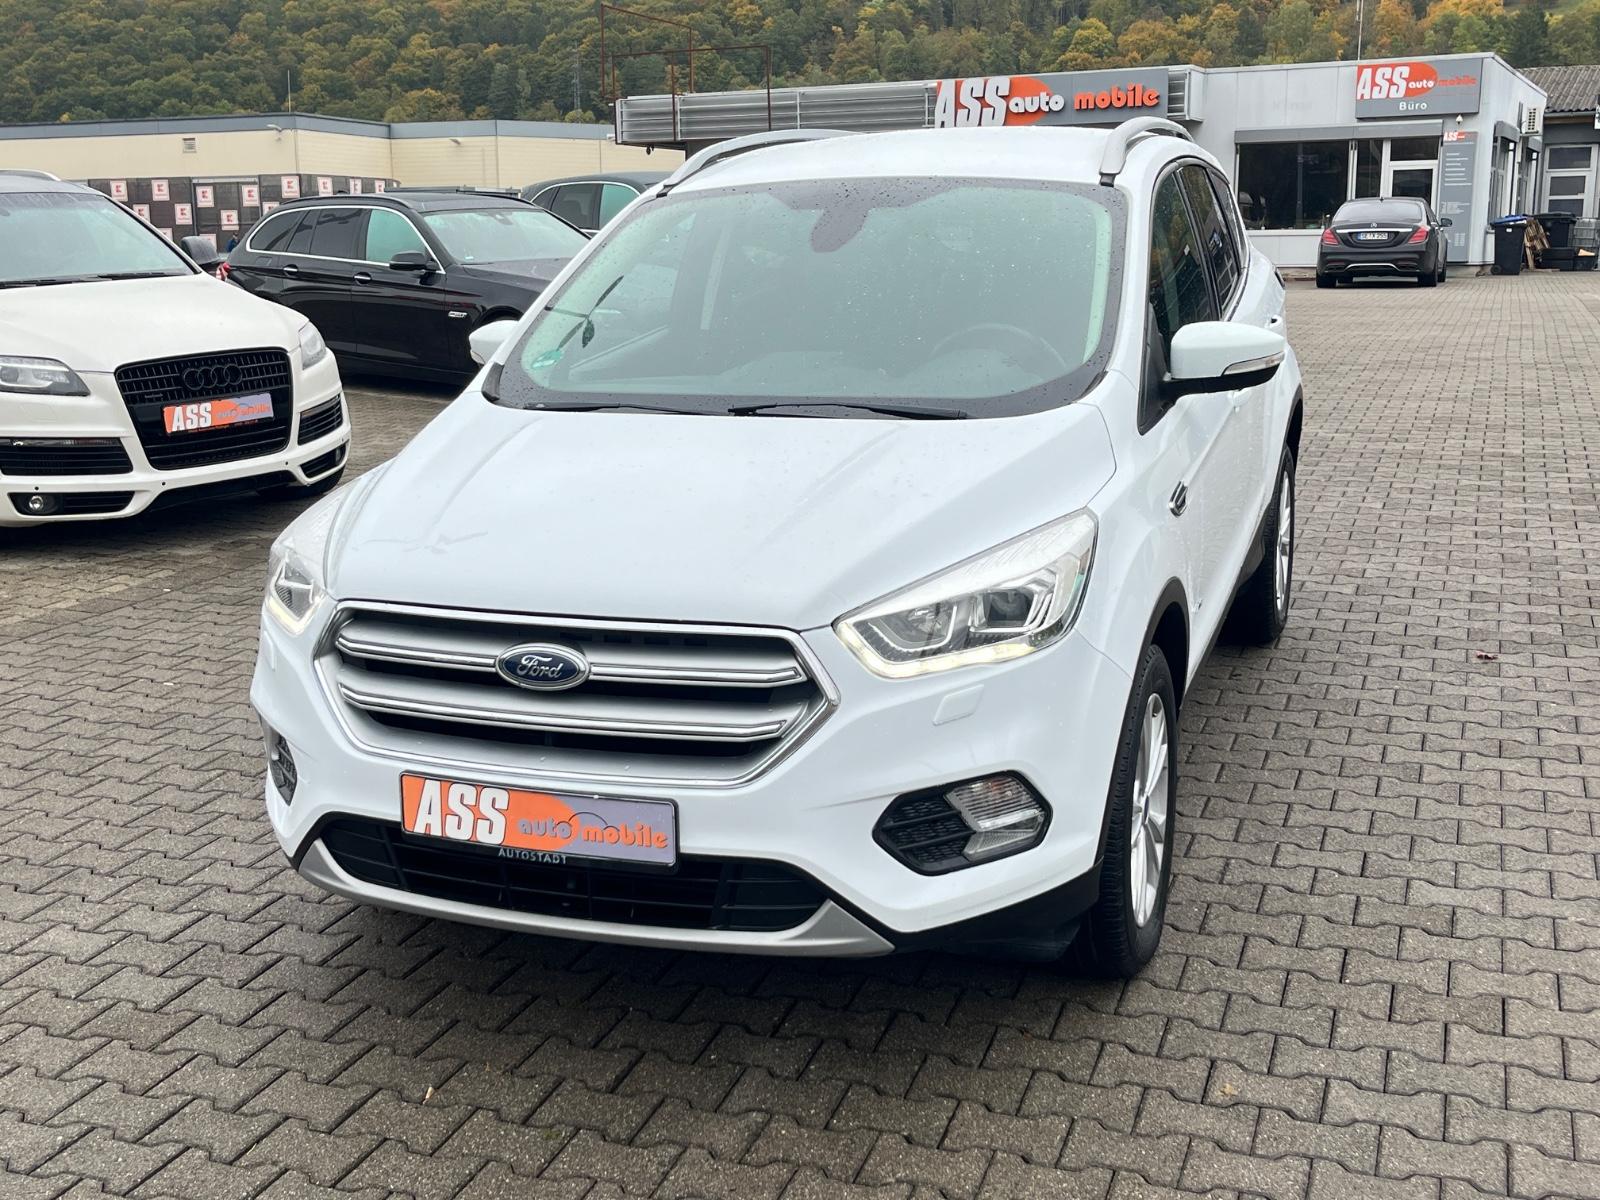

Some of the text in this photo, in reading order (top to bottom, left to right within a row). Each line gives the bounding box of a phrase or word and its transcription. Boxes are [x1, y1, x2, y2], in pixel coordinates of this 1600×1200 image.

[1357, 66, 1410, 100] ASS
[1408, 79, 1435, 89] auto
[935, 77, 1161, 128] ASS auto mobile
[1399, 102, 1428, 111] Büro
[172, 402, 212, 432] ASS
[516, 654, 563, 678] Ford
[413, 778, 669, 849] ASS auto mobile
[498, 847, 568, 865] AUTOSTADT
